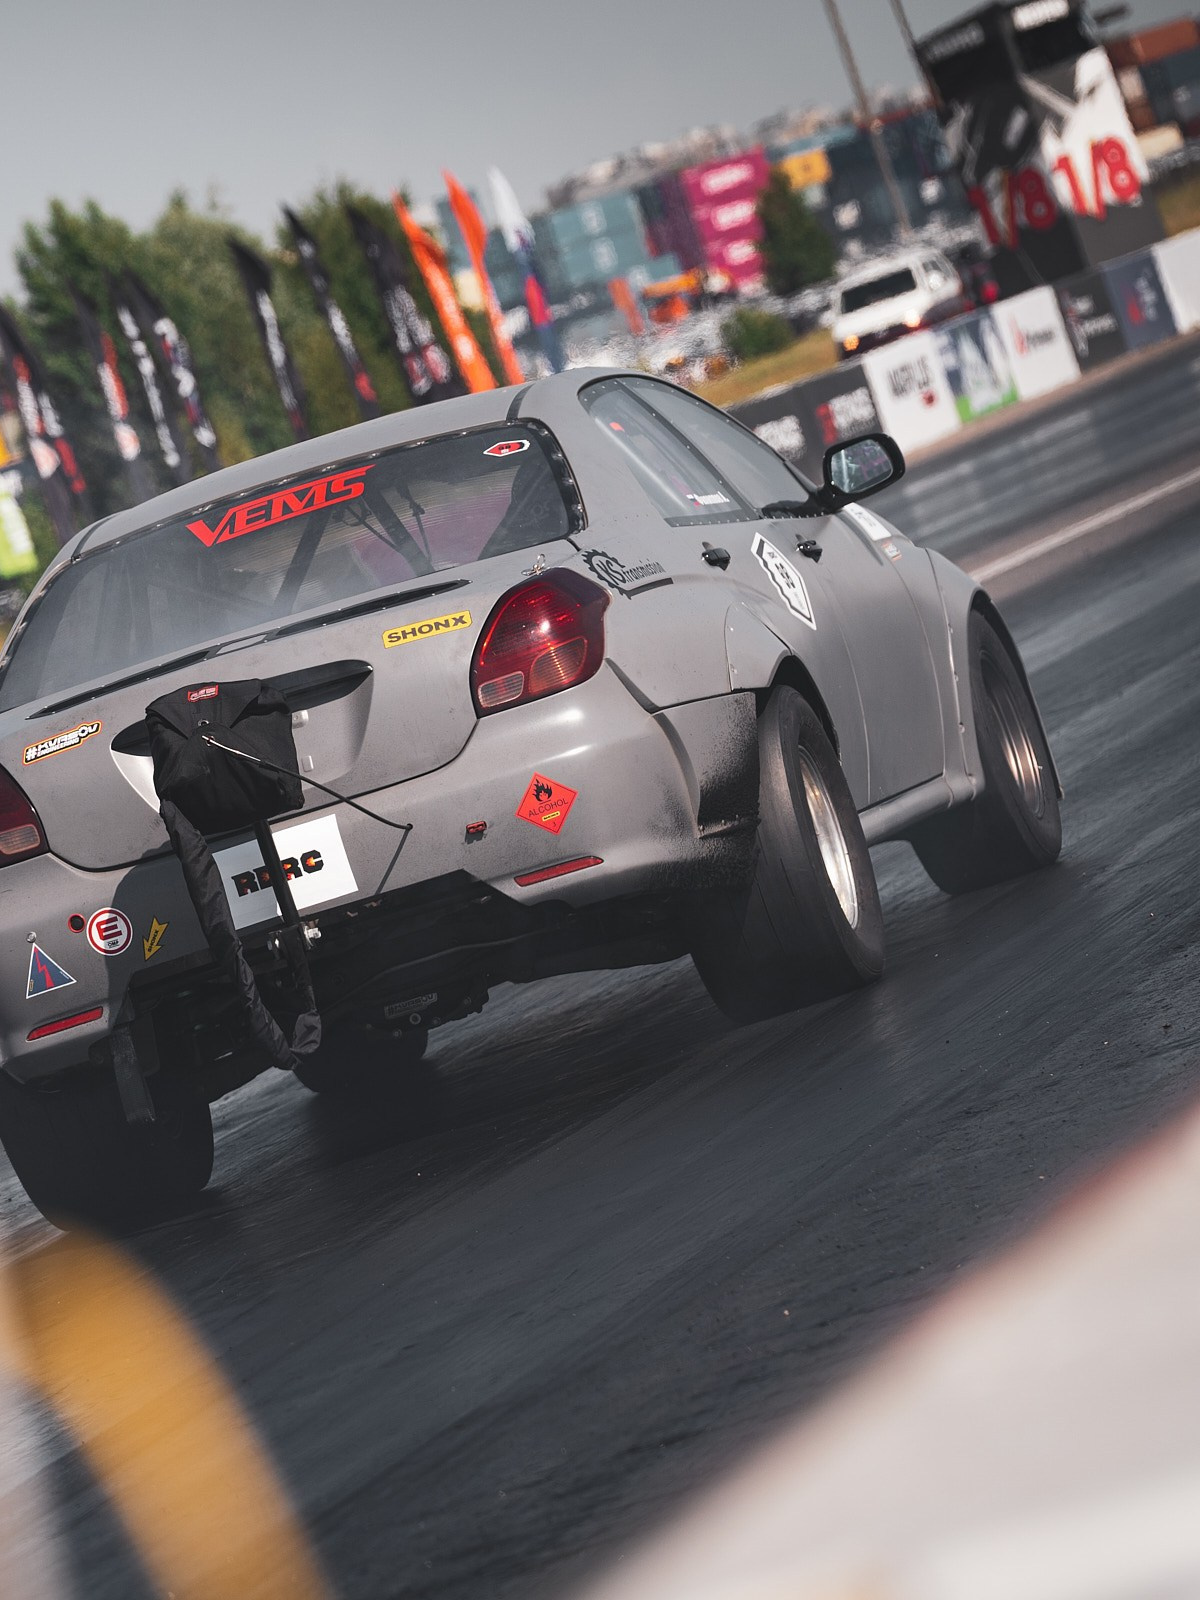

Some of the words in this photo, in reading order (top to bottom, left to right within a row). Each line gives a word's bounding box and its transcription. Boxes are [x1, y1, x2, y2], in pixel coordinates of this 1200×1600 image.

[1052, 136, 1141, 221] 1/8
[967, 166, 1056, 250] 1/8
[185, 464, 376, 547] VEMS
[387, 615, 467, 642] SHONX
[528, 798, 568, 818] ALCOHOL
[96, 916, 123, 940] E
